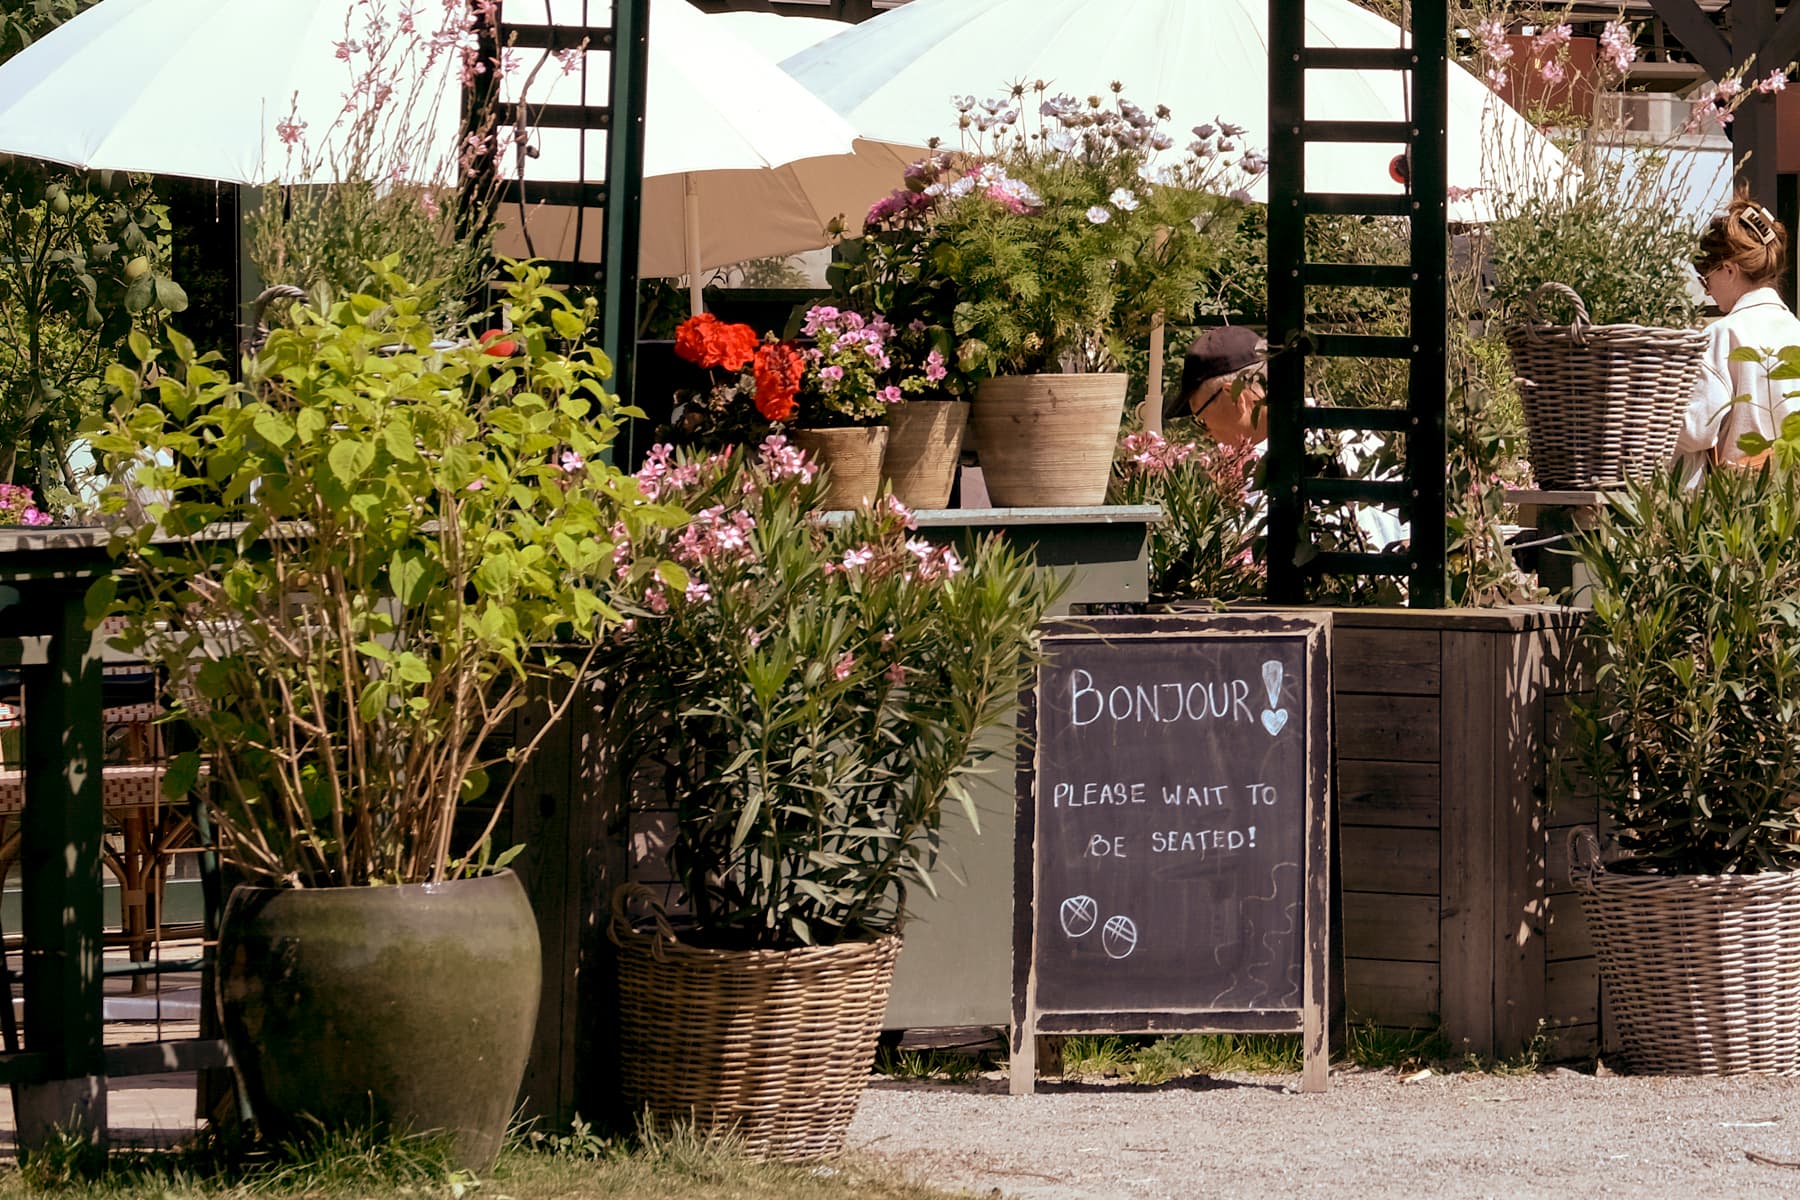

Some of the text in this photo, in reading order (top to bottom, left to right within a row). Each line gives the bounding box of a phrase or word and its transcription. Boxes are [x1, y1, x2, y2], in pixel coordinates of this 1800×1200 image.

[1071, 659, 1289, 736] BONJOUR!
[1053, 782, 1278, 808] PLEASE WAIT TO
[1086, 825, 1257, 858] BE SEATED!
